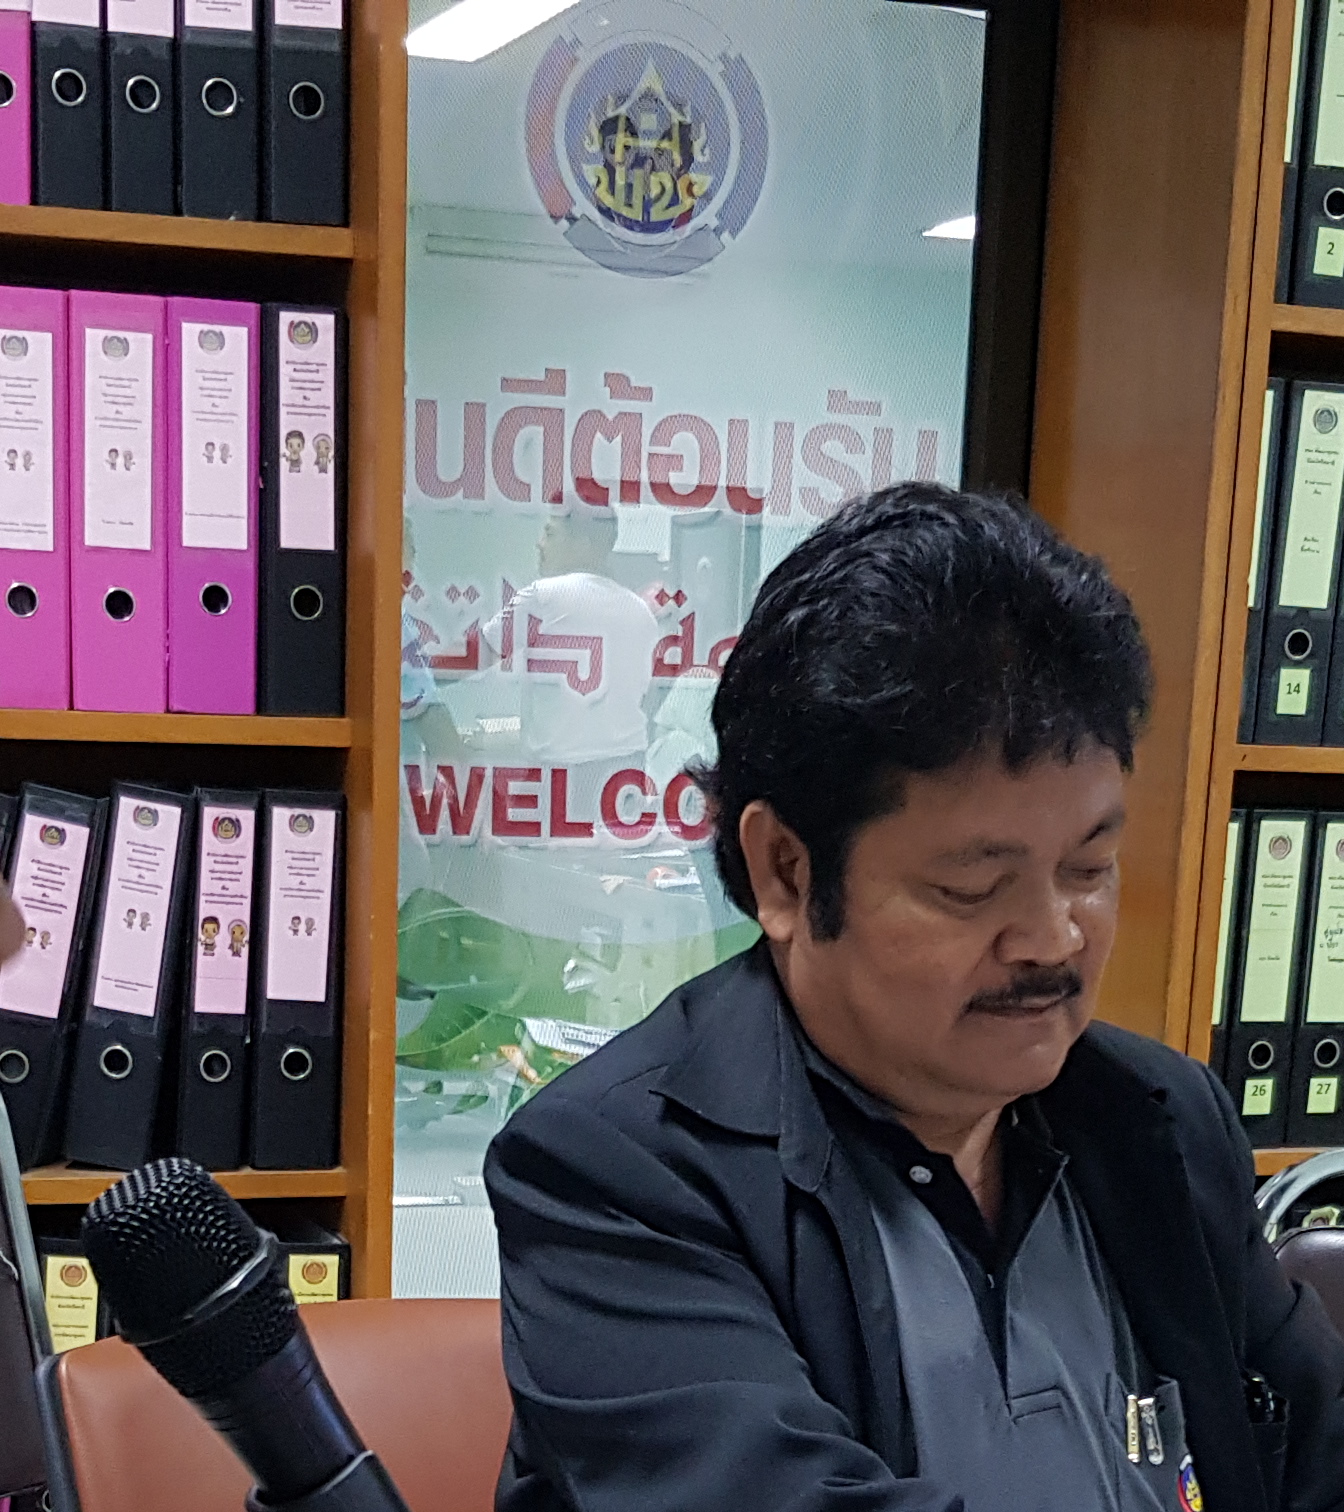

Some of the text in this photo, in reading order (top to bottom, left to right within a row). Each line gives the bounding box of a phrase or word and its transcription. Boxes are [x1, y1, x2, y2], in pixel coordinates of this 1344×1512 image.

[1326, 241, 1335, 256] 2
[414, 368, 939, 516] นดีต้อนรับ
[1286, 682, 1301, 695] 14
[404, 765, 709, 841] WELCO
[1251, 1084, 1267, 1097] 26
[1316, 1082, 1332, 1095] 27
